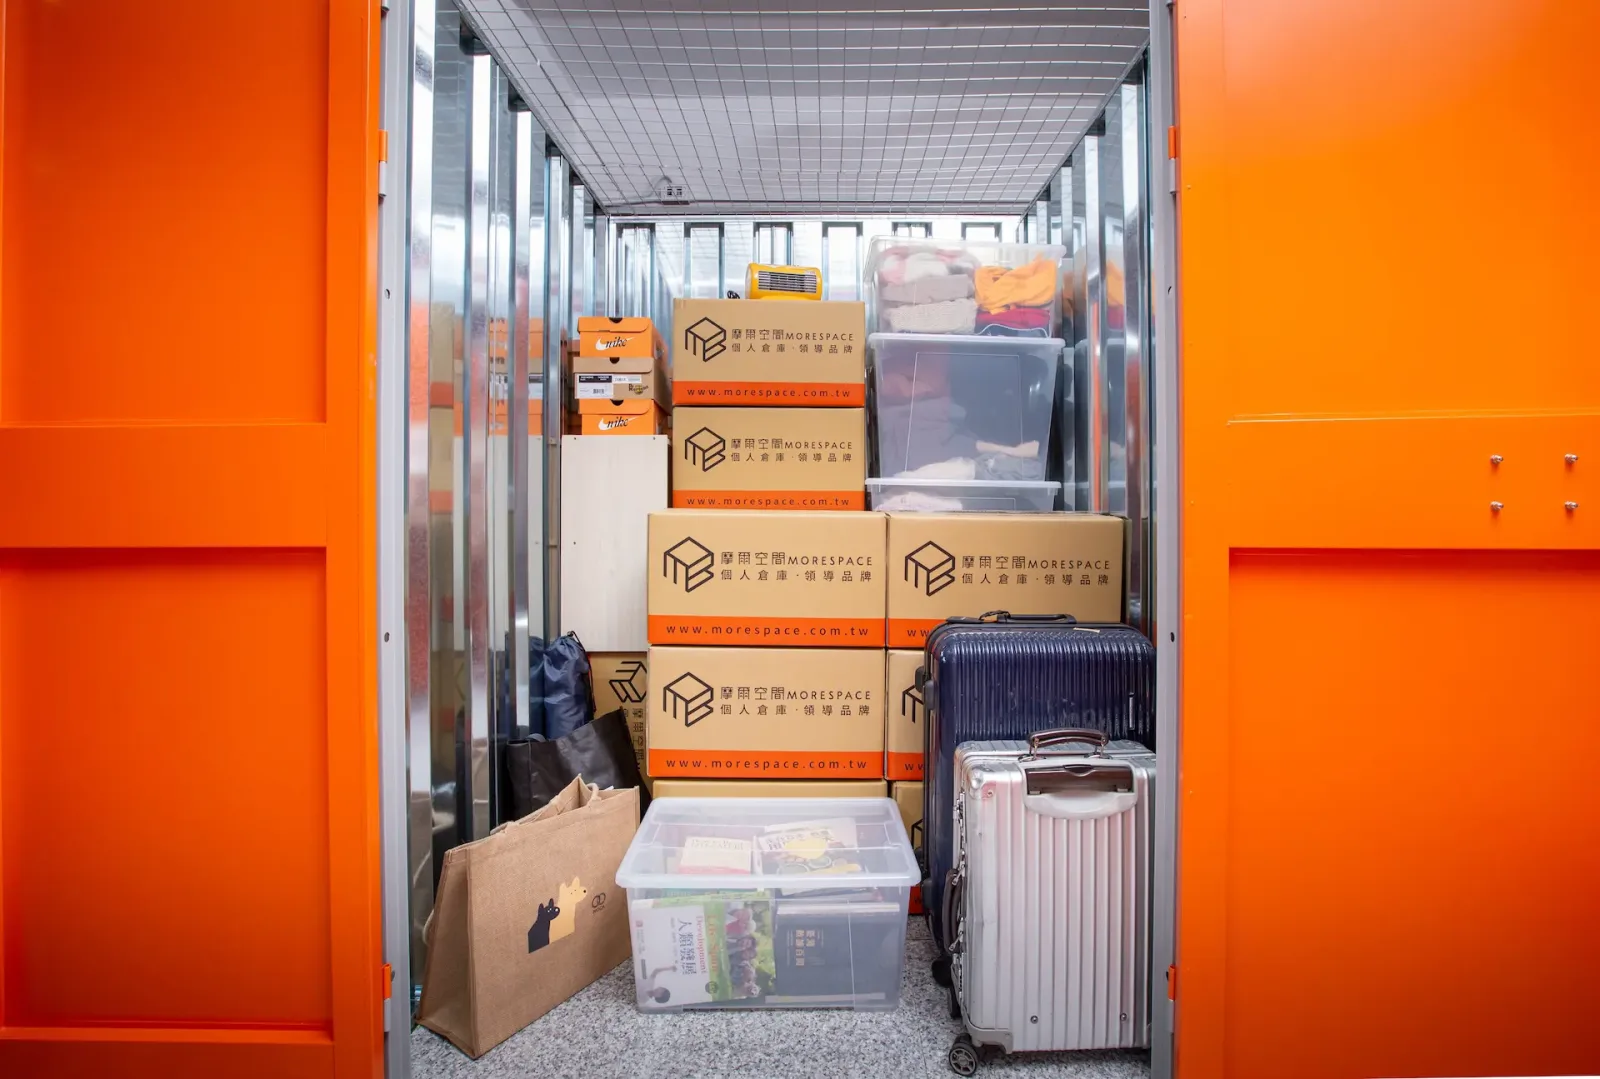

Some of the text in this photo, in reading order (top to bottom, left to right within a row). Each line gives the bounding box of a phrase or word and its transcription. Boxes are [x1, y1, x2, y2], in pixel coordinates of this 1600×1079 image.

[731, 328, 854, 342] 摩爾空間 MORESPACE
[605, 336, 628, 349] nike
[687, 388, 851, 398] www.morespace.com.tw
[606, 416, 629, 429] nike
[731, 438, 853, 450] 摩爾空間 MORESPACE
[687, 497, 850, 507] www.morespace.com.tw
[720, 551, 873, 566] 摩爾空間 MORESPACE
[962, 555, 1111, 570] 摩爾空間 MORESPACE
[666, 624, 869, 638] www.morespace.com.tw
[720, 686, 871, 701] 摩爾空間 MORESPACE
[666, 758, 868, 771] www.morespace.com.tw
